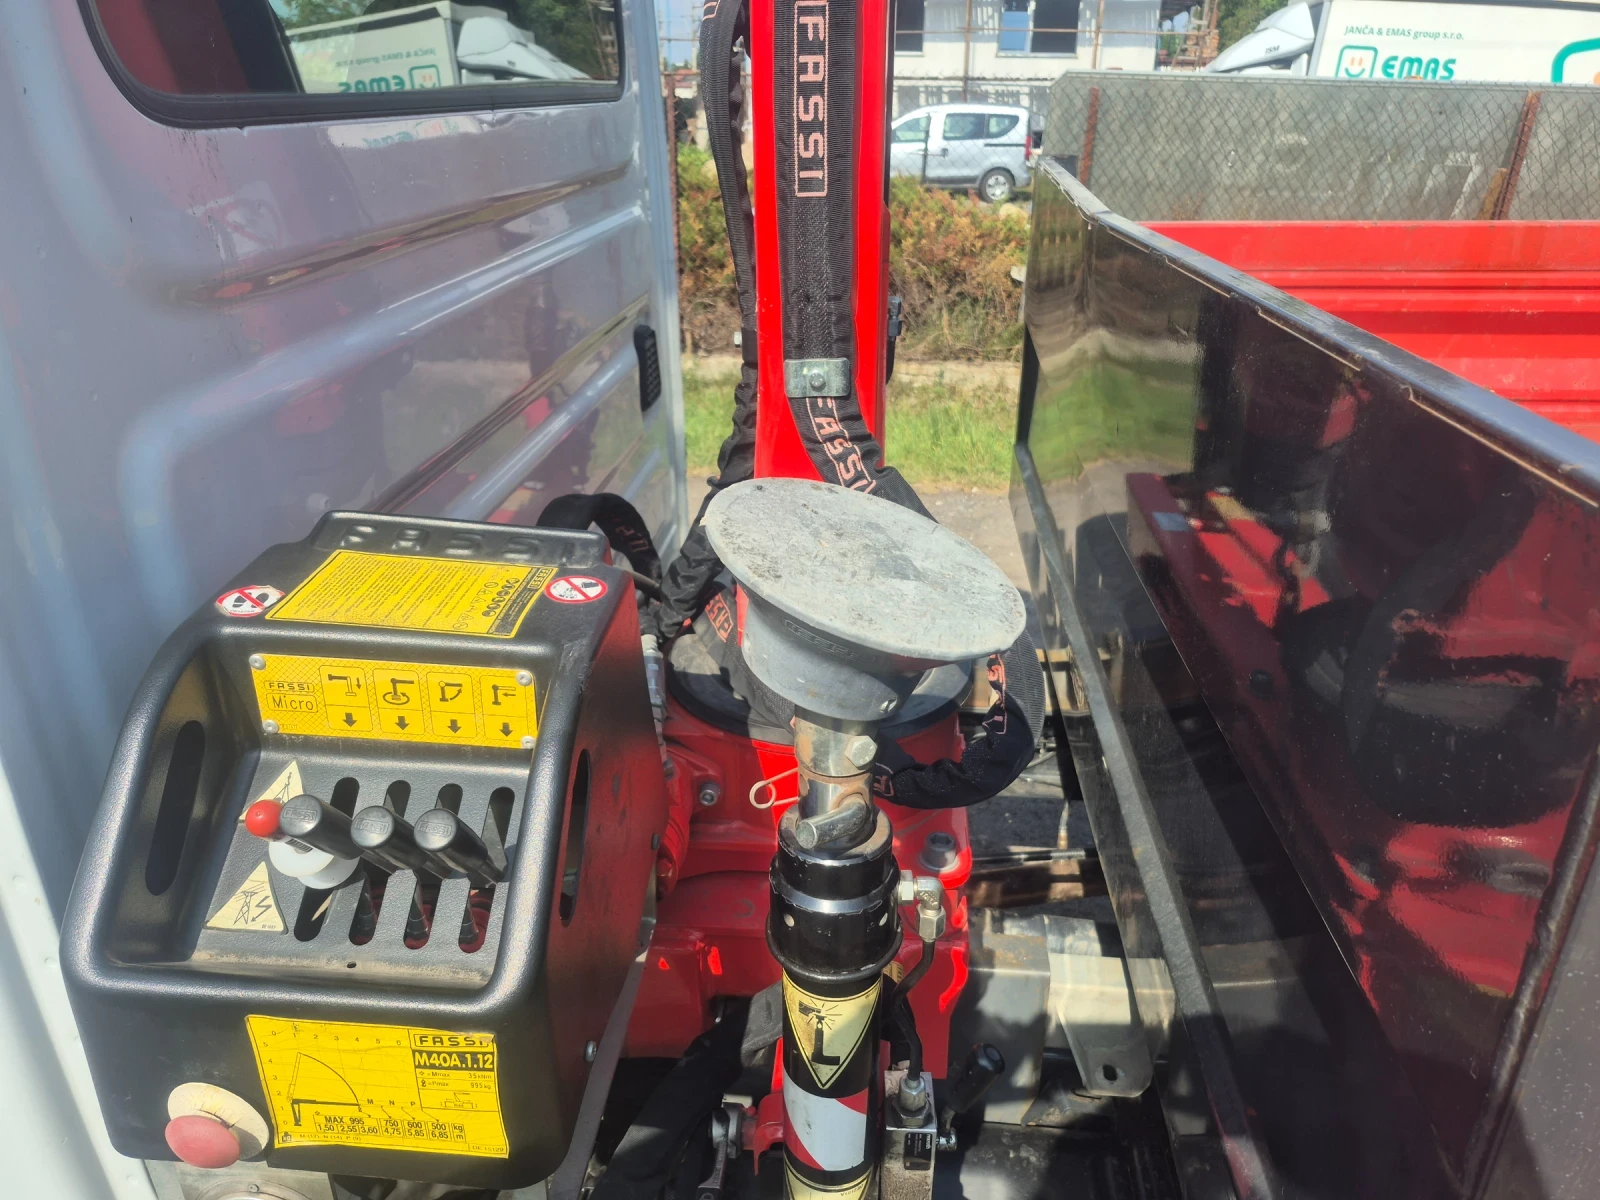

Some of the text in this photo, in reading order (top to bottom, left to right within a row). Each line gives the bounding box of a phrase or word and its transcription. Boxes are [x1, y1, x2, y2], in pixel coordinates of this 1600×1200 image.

[1344, 24, 1465, 40] JANČA & EMAS group s.r.o.
[1381, 55, 1457, 80] EMAS
[799, 15, 825, 179] FASSI
[268, 682, 311, 691] FASSI
[272, 695, 314, 711] Micro
[414, 1051, 494, 1069] M40A.1.12
[317, 1124, 335, 1132] 1,50
[340, 1125, 358, 1133] 2,55
[361, 1126, 378, 1135] 3,60
[384, 1127, 402, 1136] 4,75
[407, 1129, 425, 1138] 5,85
[431, 1130, 449, 1140] 6,85
[349, 1117, 365, 1126] 995
[407, 1121, 423, 1129] 600
[431, 1122, 447, 1131] 500
[453, 1124, 463, 1133] kg
